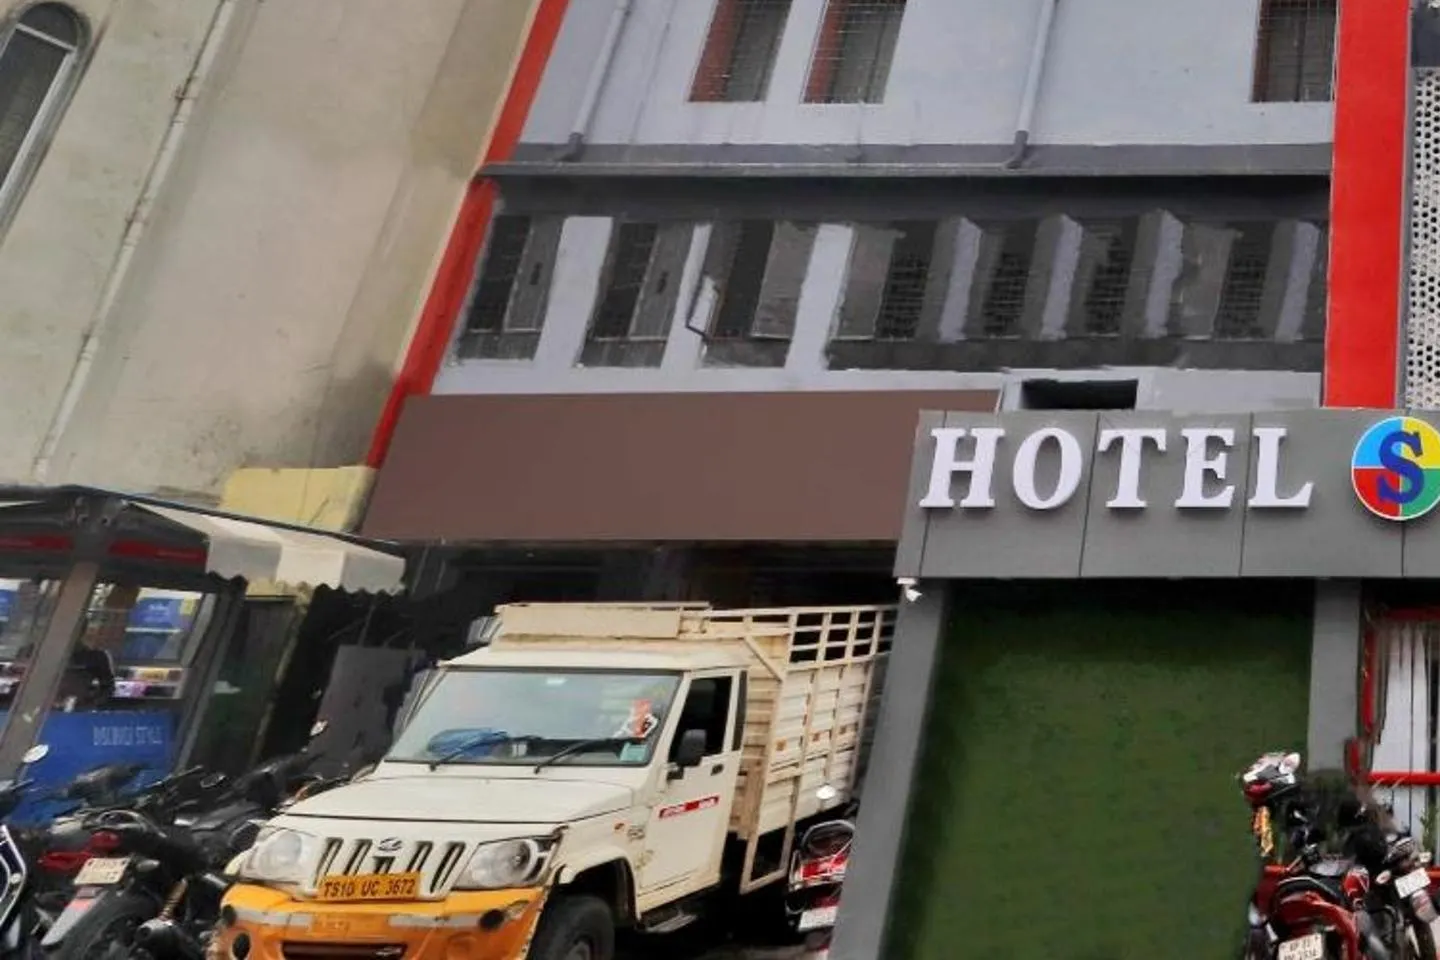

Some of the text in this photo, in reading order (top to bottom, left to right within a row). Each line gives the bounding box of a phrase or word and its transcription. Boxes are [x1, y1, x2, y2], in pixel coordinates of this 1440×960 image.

[919, 426, 1315, 510] HOTEL
[323, 881, 356, 898] TS10
[360, 880, 380, 897] UC
